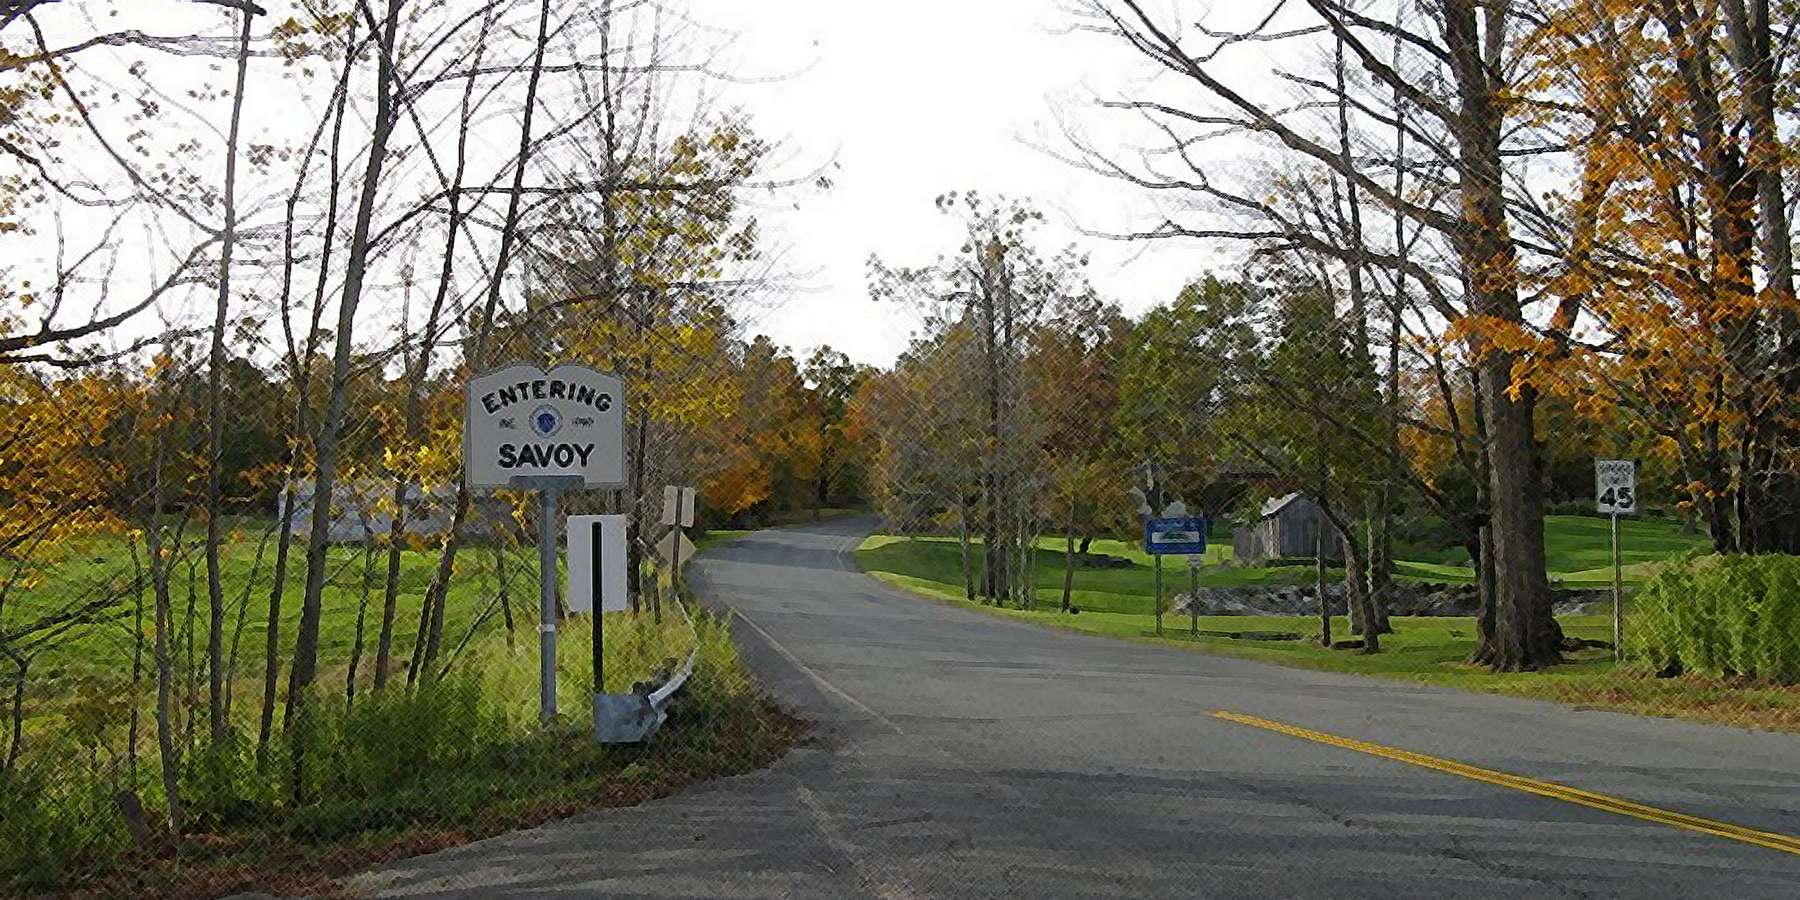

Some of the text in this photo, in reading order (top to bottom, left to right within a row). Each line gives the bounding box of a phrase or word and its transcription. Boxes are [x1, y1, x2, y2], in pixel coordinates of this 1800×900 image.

[481, 379, 613, 414] ENTERING
[498, 443, 595, 468] SAVOY
[1599, 487, 1633, 508] 45
